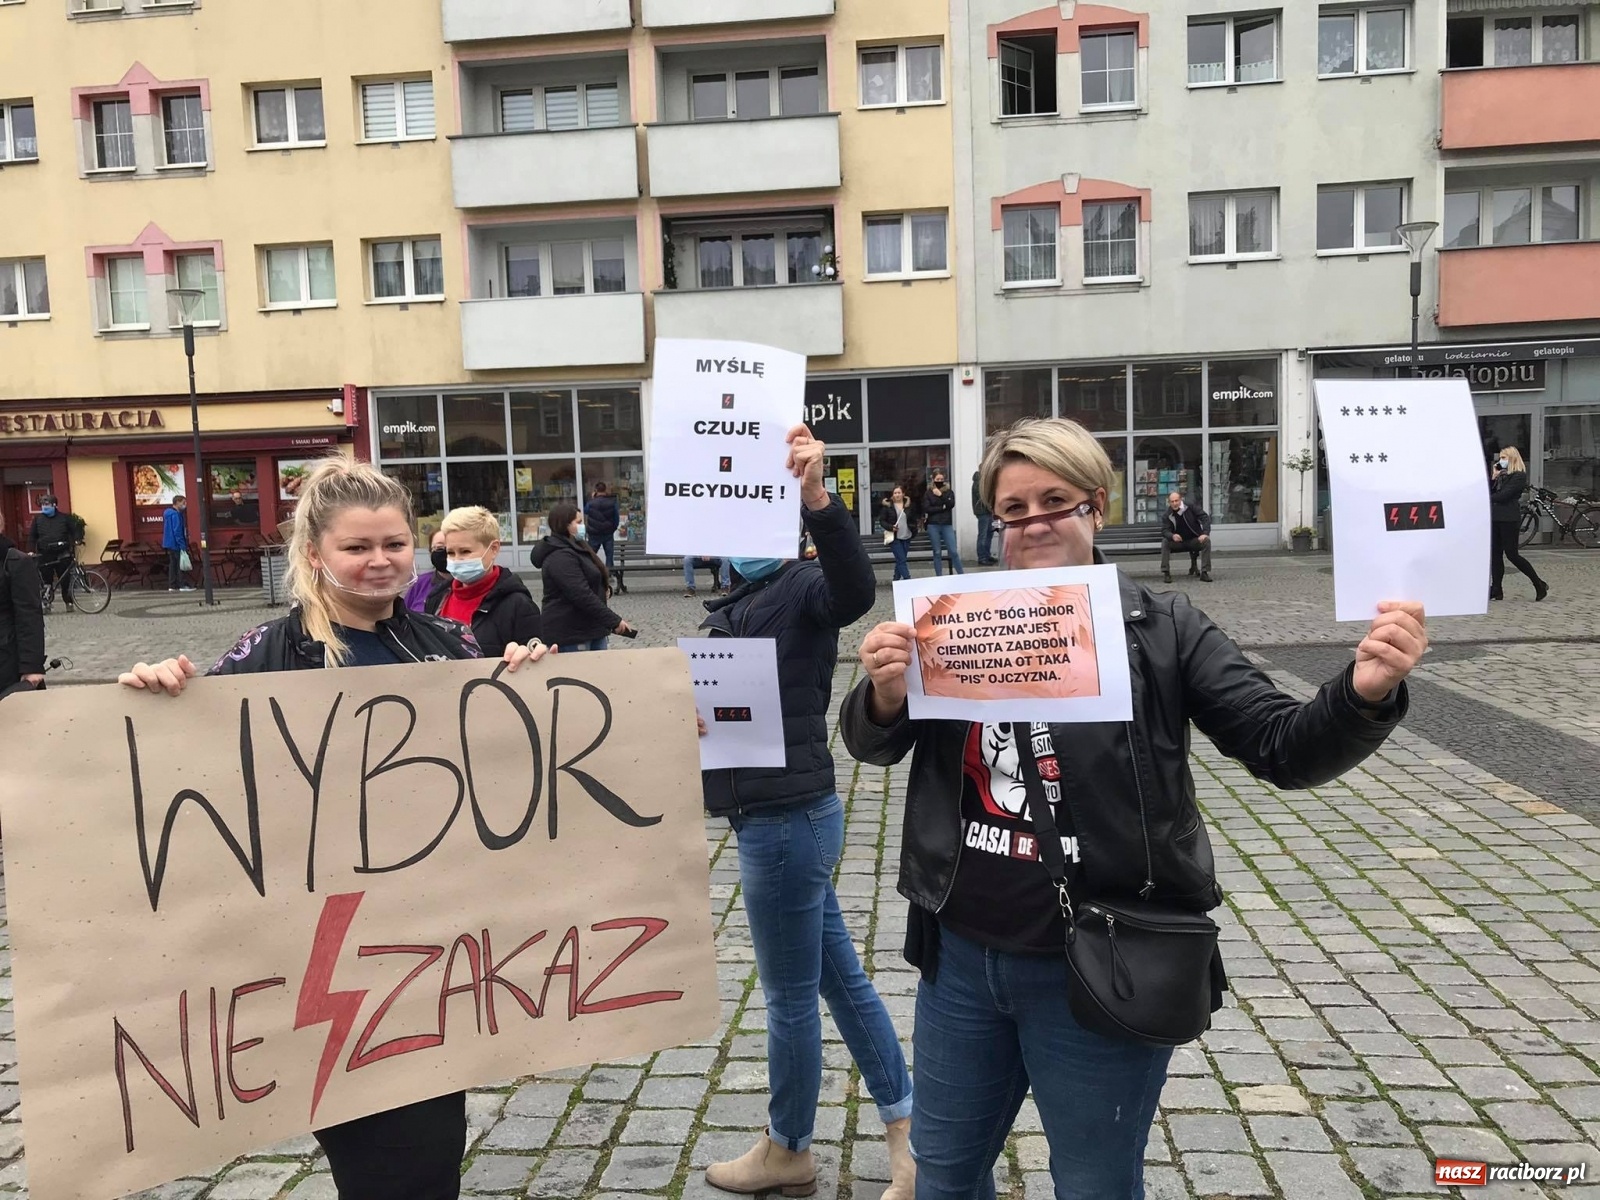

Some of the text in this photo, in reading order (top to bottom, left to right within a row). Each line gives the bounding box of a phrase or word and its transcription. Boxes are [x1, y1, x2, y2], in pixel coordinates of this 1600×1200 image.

[1384, 354, 1425, 364] gelatou
[1533, 346, 1575, 357] gelatopiu
[696, 357, 765, 378] MYŚLĘ
[1415, 362, 1536, 388] elatopiu
[1212, 386, 1274, 401] empik.com
[803, 393, 852, 426] pik
[383, 420, 437, 435] empik.com
[694, 420, 760, 440] CZUJĘ
[664, 482, 774, 503] DECYDUJĘ
[931, 604, 1074, 626] MIAŁ BYĆ "BÓG HONOR
[949, 629, 954, 640] I
[936, 636, 1076, 656] CIEMNOTA ZABOBON I
[944, 653, 1071, 670] ZGNILIZNA OT TAKA
[955, 670, 1062, 684] "PIS" OJCZYZNA.
[125, 662, 663, 912] WYBÓR
[965, 820, 1011, 857] CASA
[1017, 836, 1034, 856] DE
[112, 916, 684, 1154] NIE ZAKAZ
